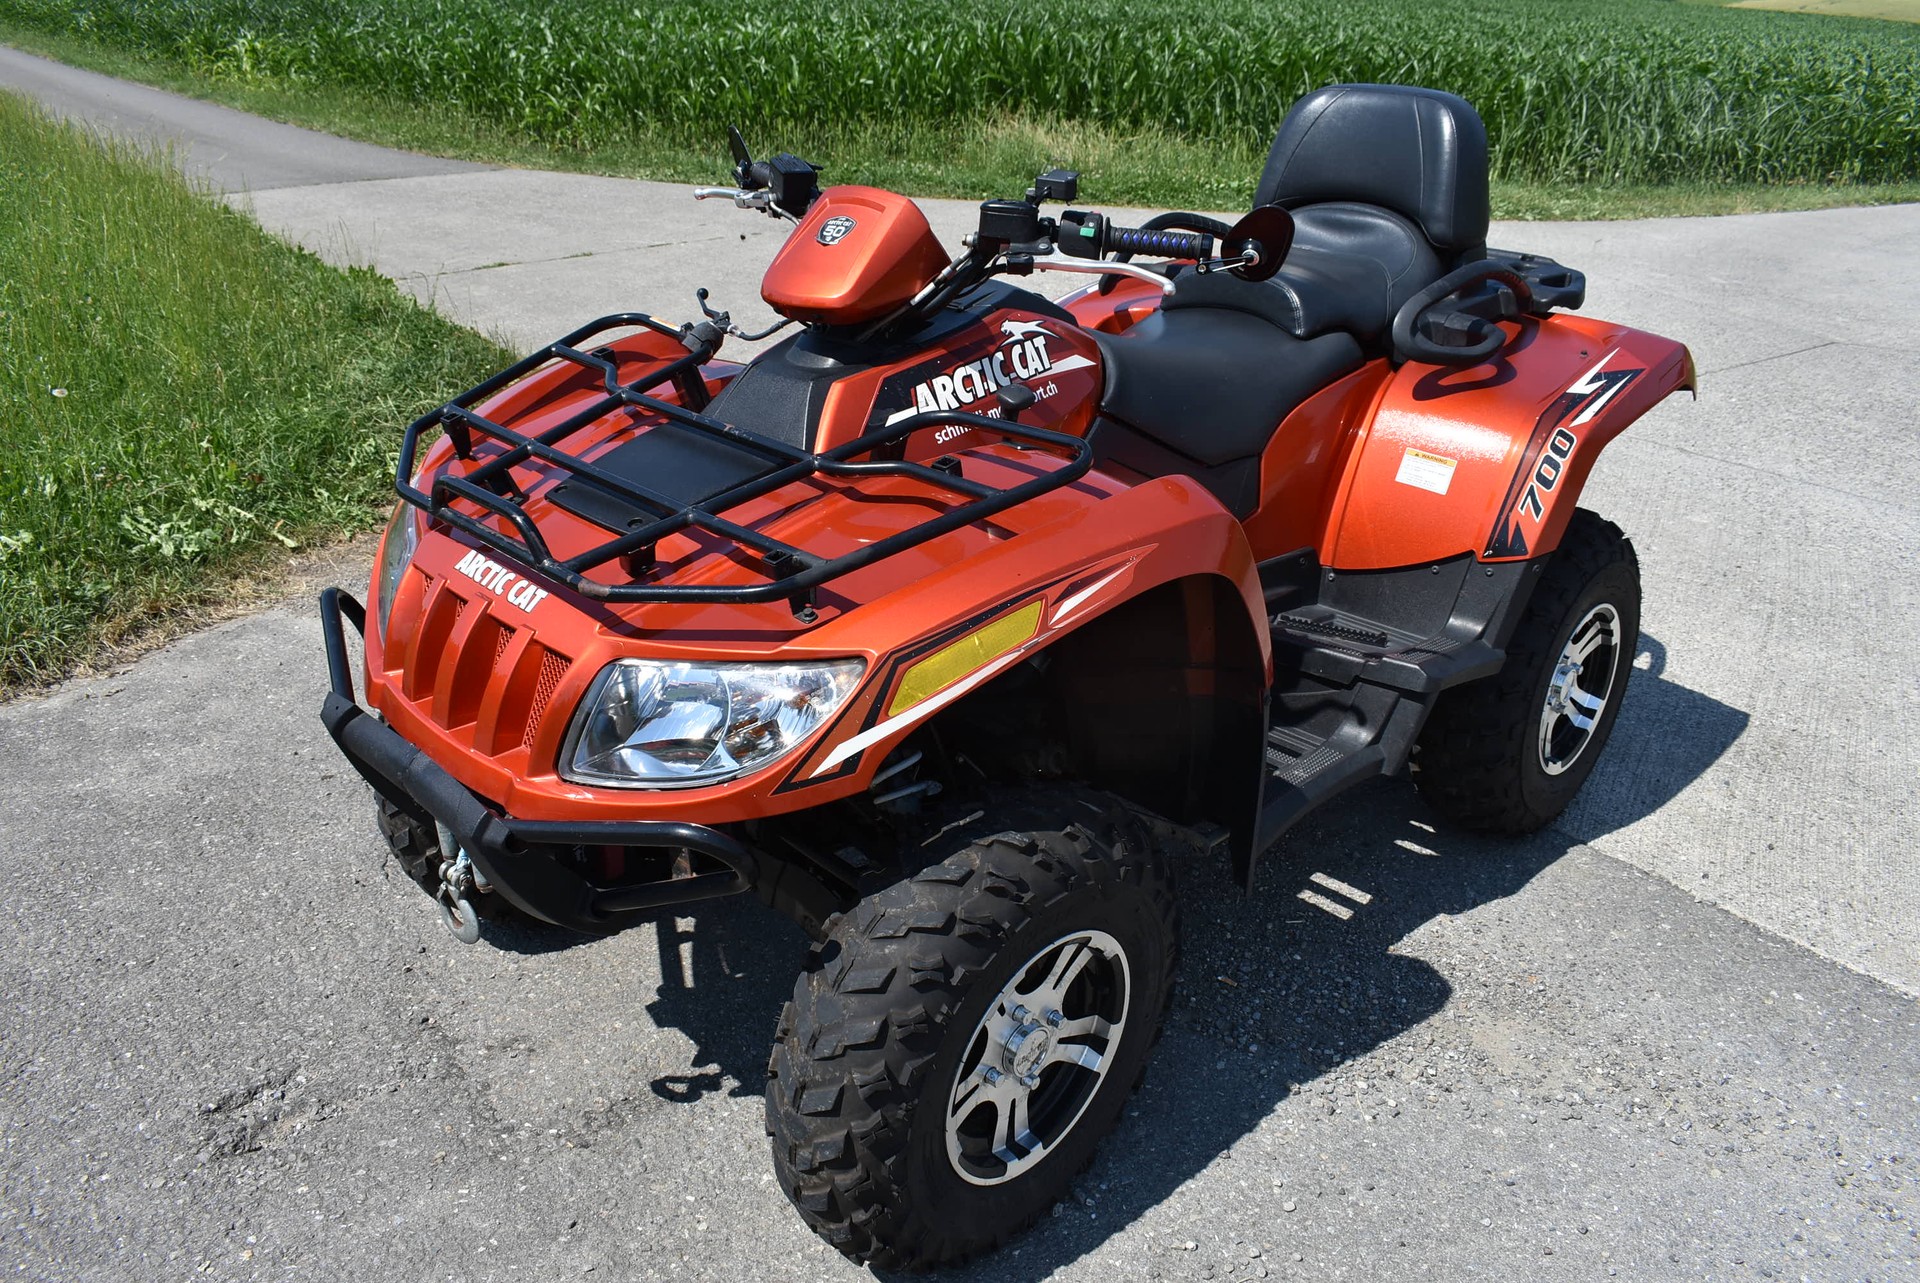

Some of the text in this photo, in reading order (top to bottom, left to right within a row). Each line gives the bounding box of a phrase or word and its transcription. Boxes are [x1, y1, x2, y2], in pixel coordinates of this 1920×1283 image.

[823, 225, 845, 237] 50
[915, 336, 1051, 412] ARCTIC CAT
[1421, 453, 1448, 465] WARNING
[1518, 427, 1577, 524] 700
[454, 549, 549, 613] ARCTIC CAT
